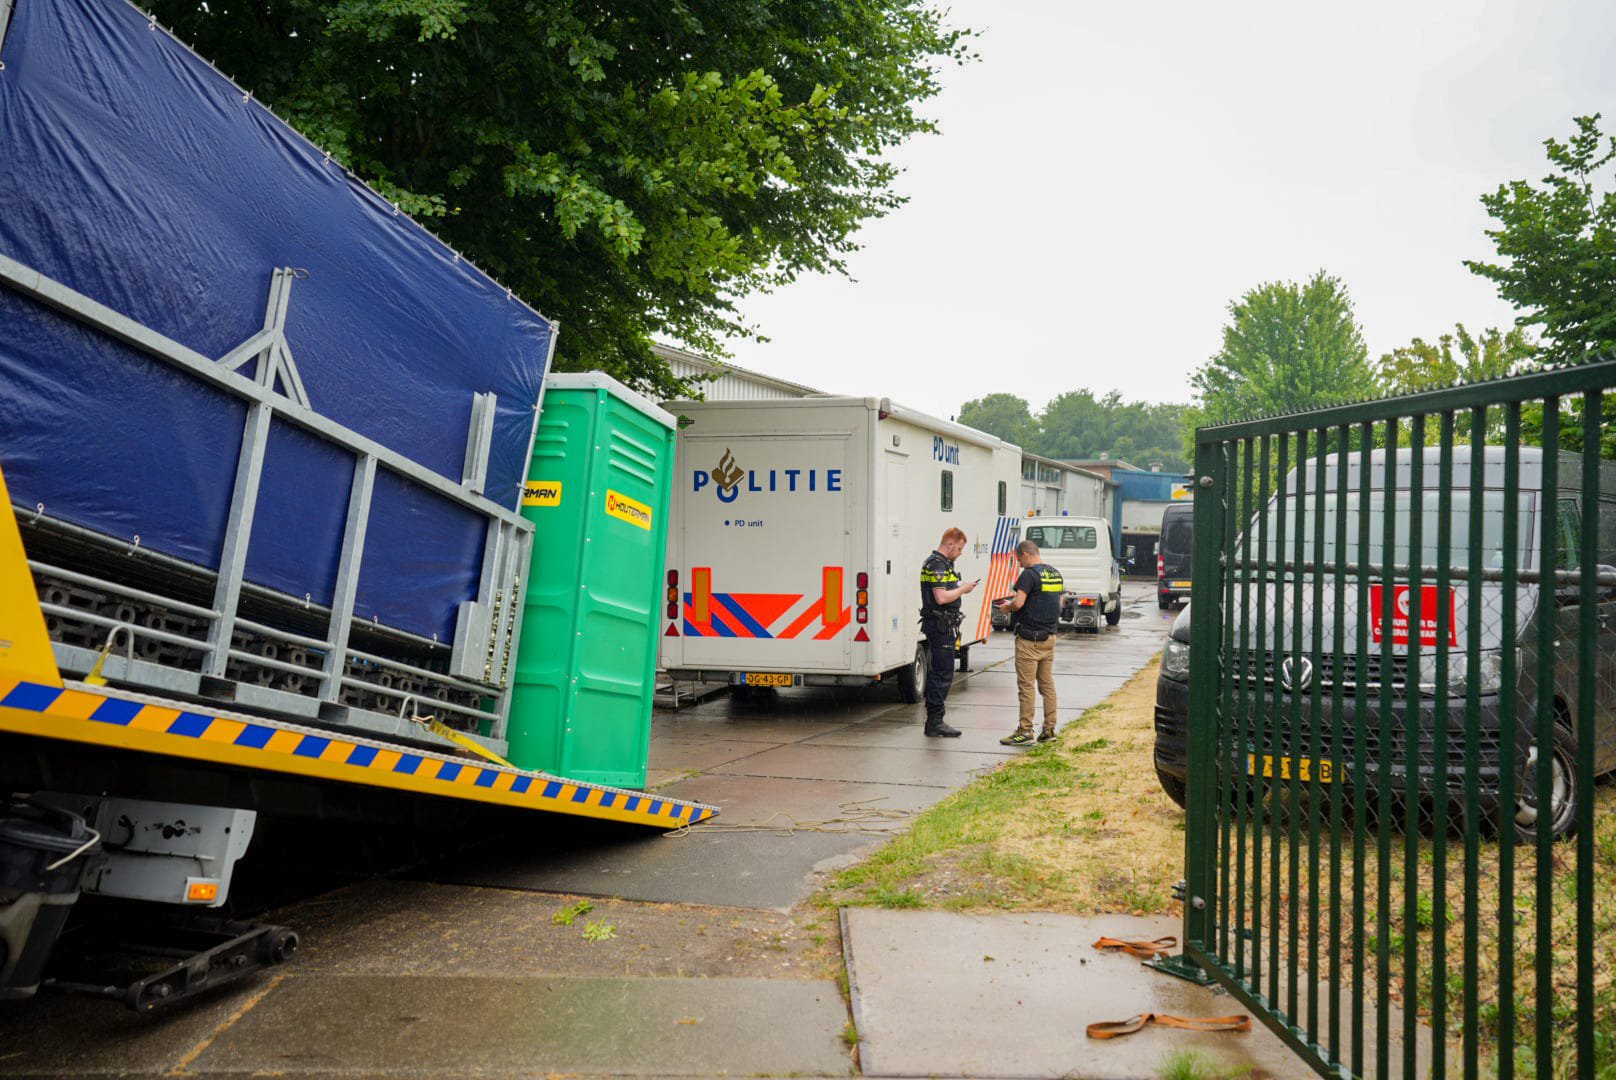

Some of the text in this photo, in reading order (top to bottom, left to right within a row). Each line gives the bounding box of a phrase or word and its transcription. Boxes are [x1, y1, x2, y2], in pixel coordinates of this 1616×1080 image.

[933, 434, 960, 466] PD unit
[523, 488, 557, 499] RMAN
[693, 469, 842, 503] POLITIE
[748, 519, 763, 527] unit
